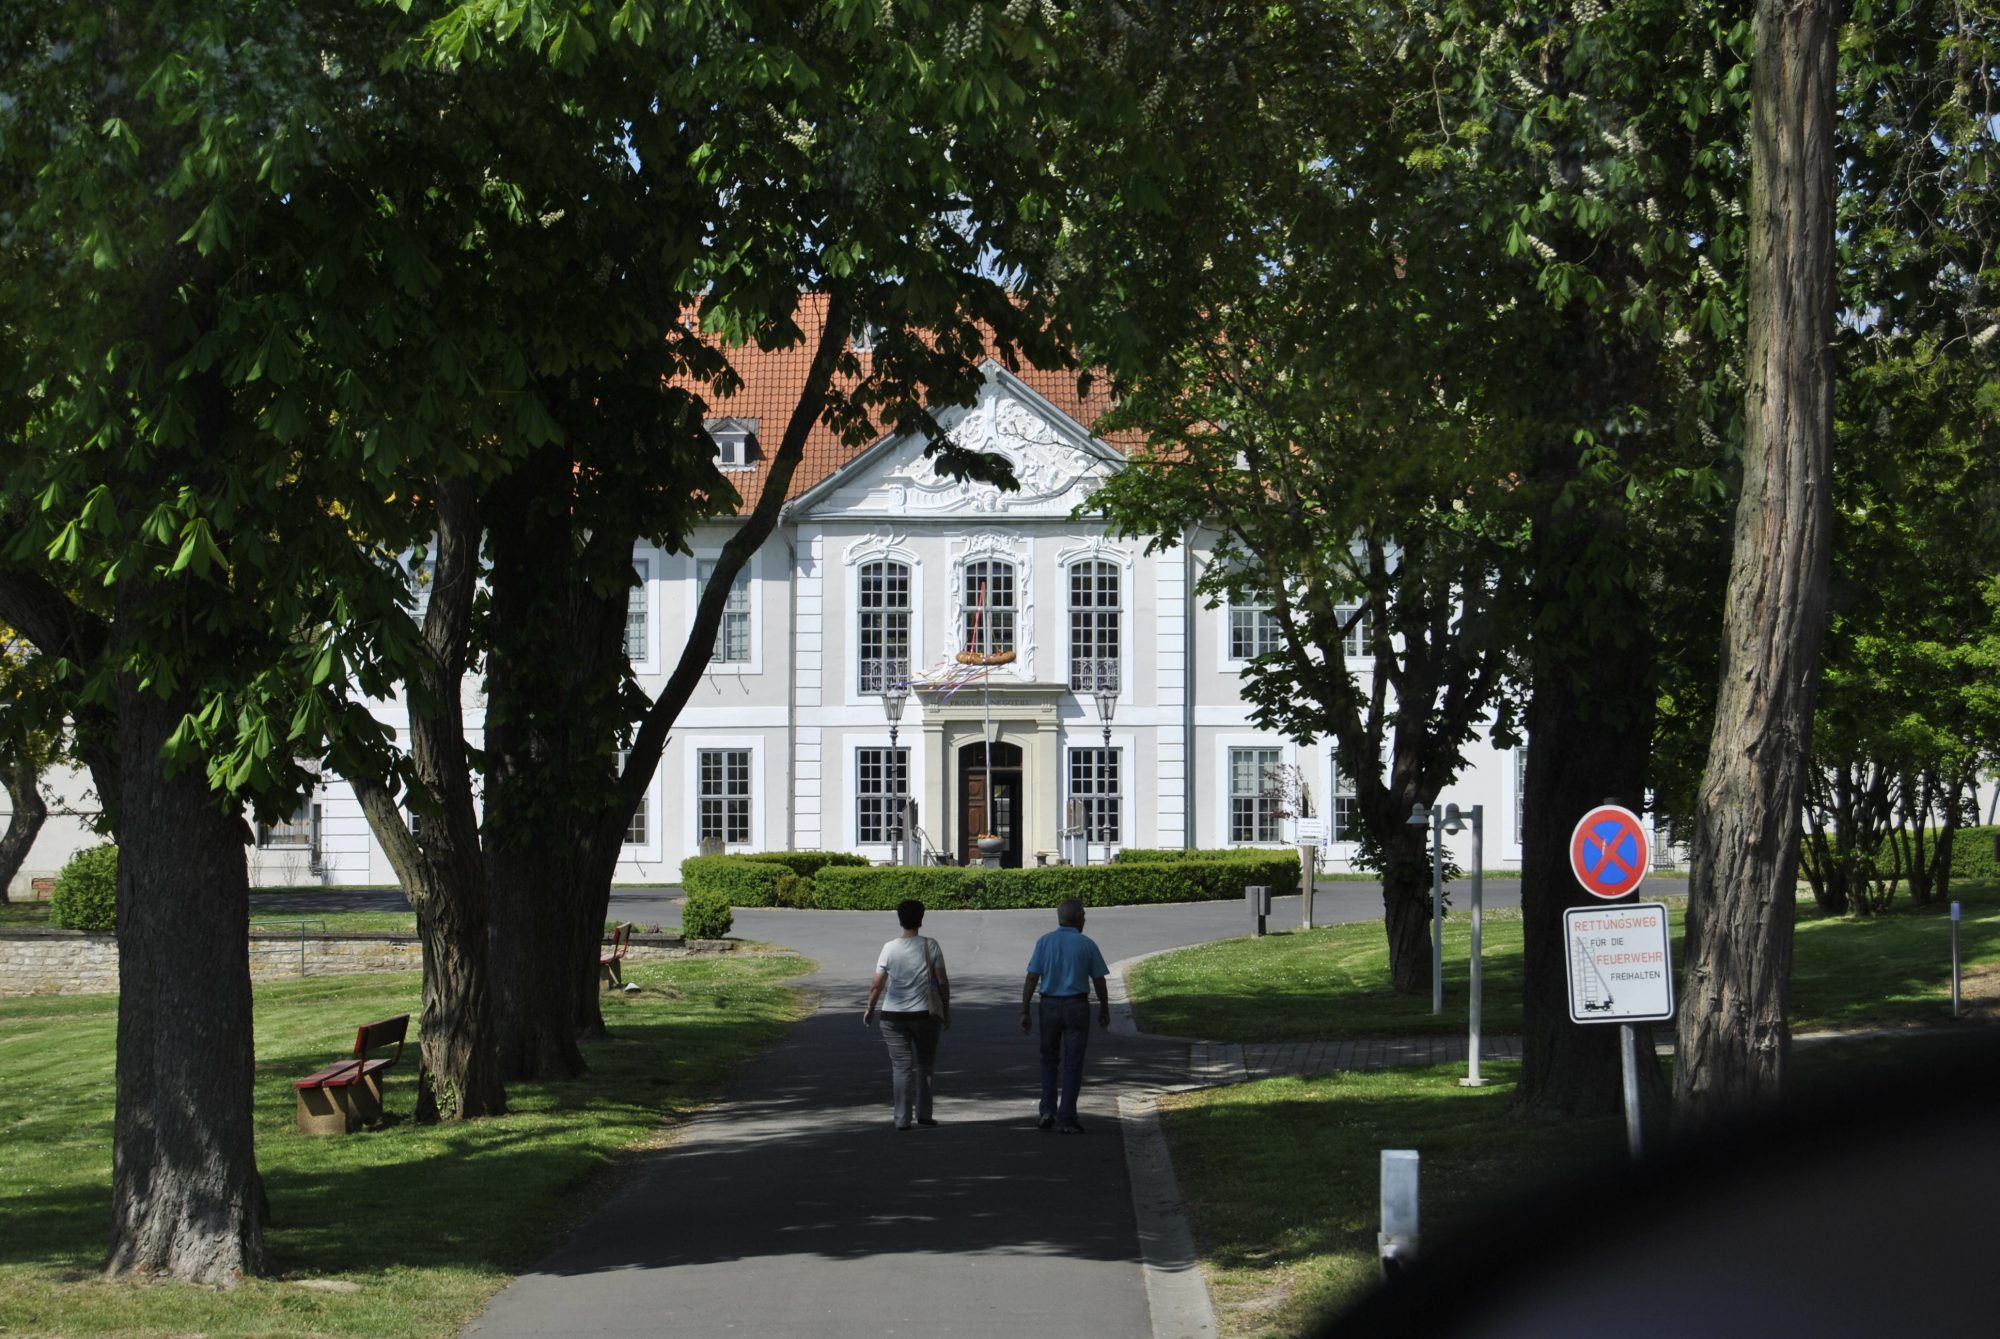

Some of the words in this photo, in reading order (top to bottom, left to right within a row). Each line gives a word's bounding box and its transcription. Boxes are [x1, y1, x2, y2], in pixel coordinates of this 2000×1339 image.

[1574, 917, 1656, 931] RETTUNGSWEG
[1590, 938, 1606, 947] FÜR
[1611, 938, 1624, 946] DIE
[1596, 952, 1663, 965] FEUERWEHR
[1610, 971, 1661, 980] FREIHALTEN
